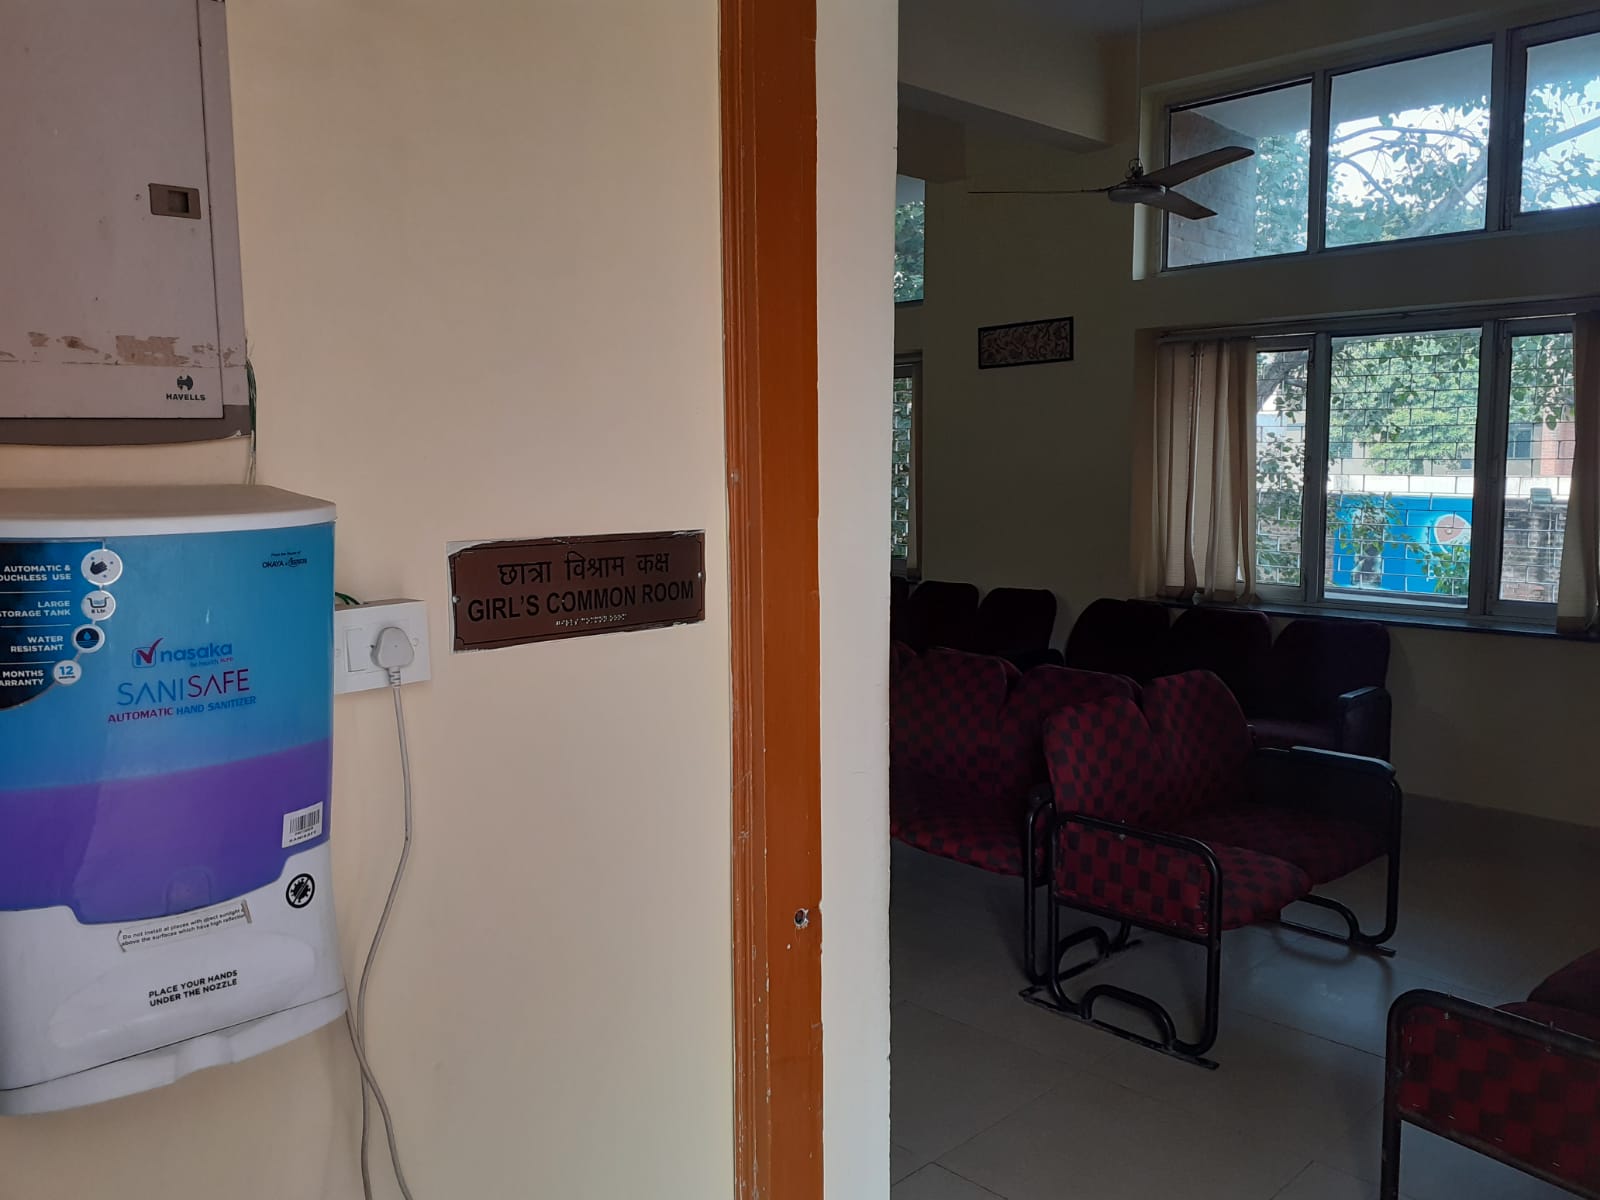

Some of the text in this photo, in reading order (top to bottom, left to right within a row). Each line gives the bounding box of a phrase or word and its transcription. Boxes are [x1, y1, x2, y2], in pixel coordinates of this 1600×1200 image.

[166, 393, 206, 401] HAVELLS
[4, 564, 62, 573] AUTOMATIC
[497, 550, 670, 586] छात्रा विश्राम कक्ष
[52, 573, 72, 581] USE
[546, 585, 636, 614] COMMON
[641, 579, 694, 604] ROOM
[37, 600, 71, 608] LARGE
[0, 609, 71, 618] TORAGE TANK
[27, 635, 64, 644] WATER
[10, 644, 64, 653] RESISTANT
[160, 642, 233, 663] nasaka
[2, 669, 44, 678] MONTHS
[59, 665, 75, 675] 12
[107, 695, 257, 724] AUTOMATIC HAND SANITIZER
[148, 969, 238, 999] PLACE YOUR HANDS
[149, 978, 238, 1007] UNDER THE NOZZLE
